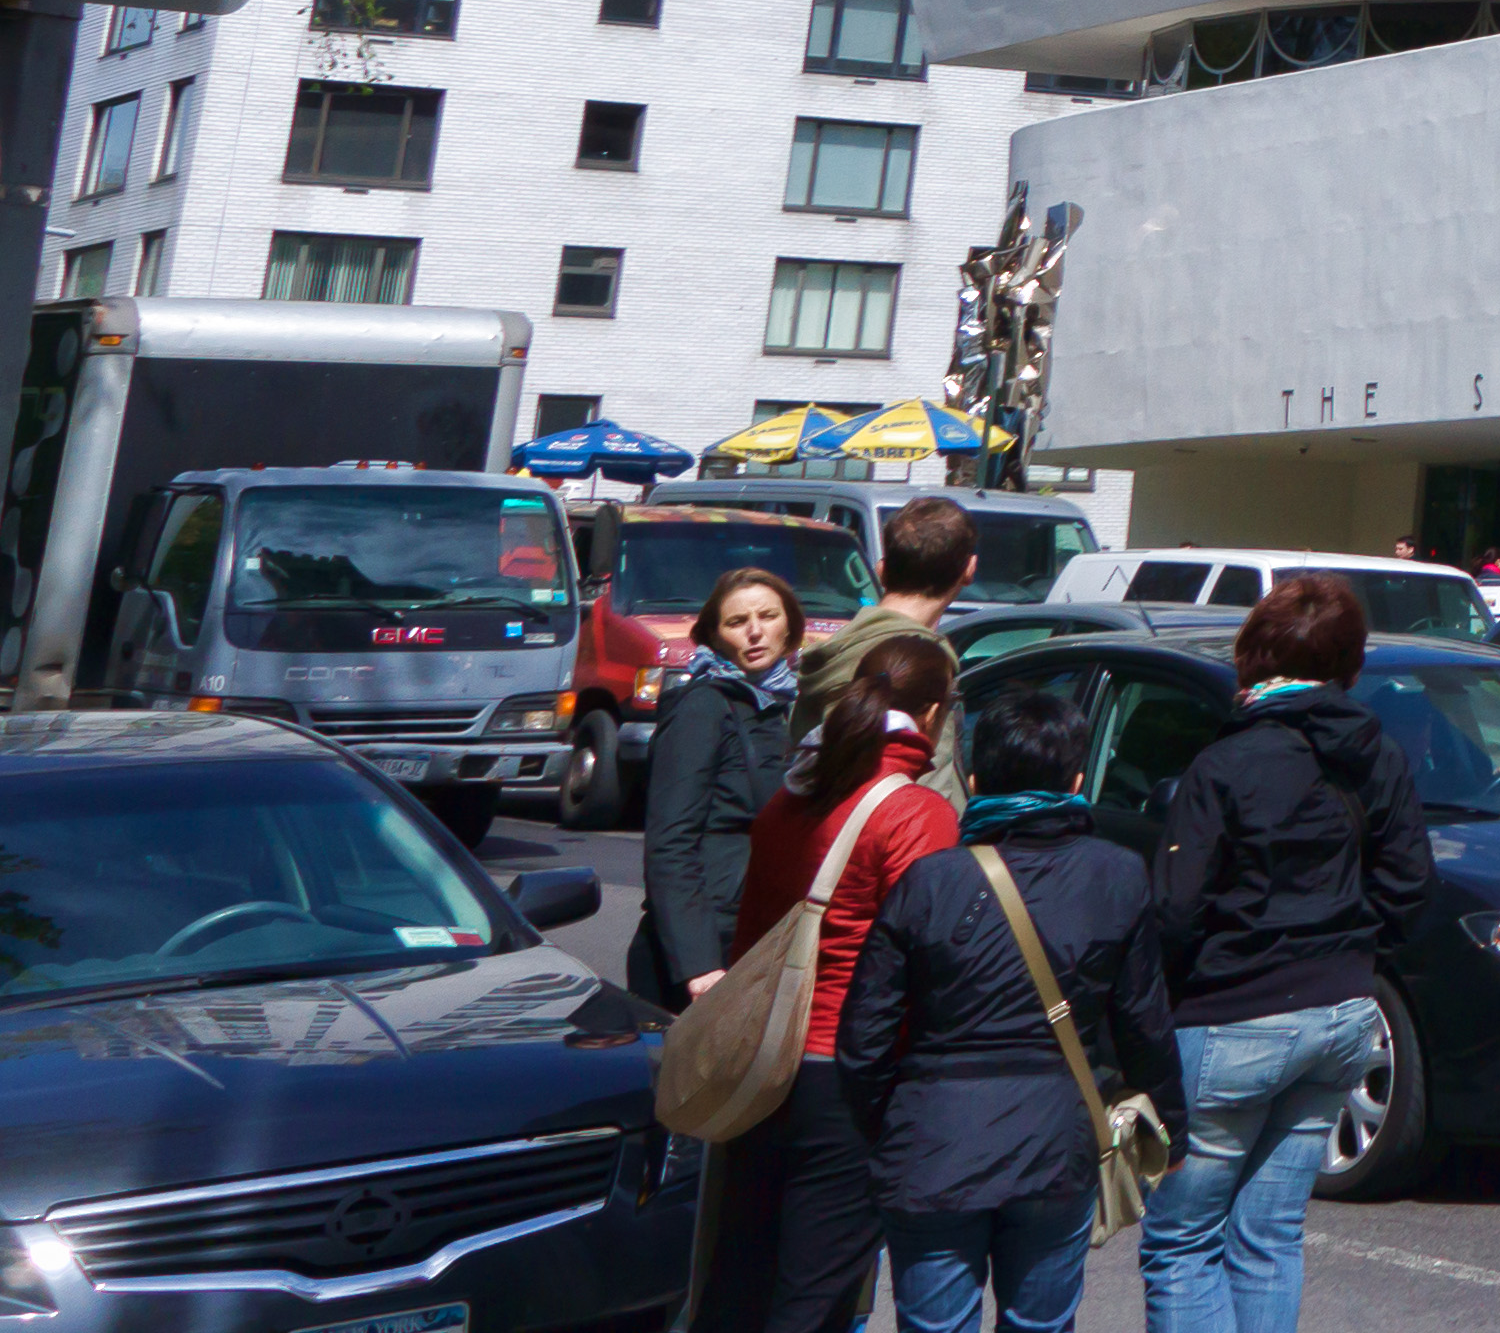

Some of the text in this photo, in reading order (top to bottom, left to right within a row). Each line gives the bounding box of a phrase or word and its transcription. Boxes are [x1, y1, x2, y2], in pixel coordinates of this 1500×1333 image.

[1281, 381, 1380, 430] THE
[850, 447, 930, 459] SABRETT
[372, 627, 446, 645] GMC
